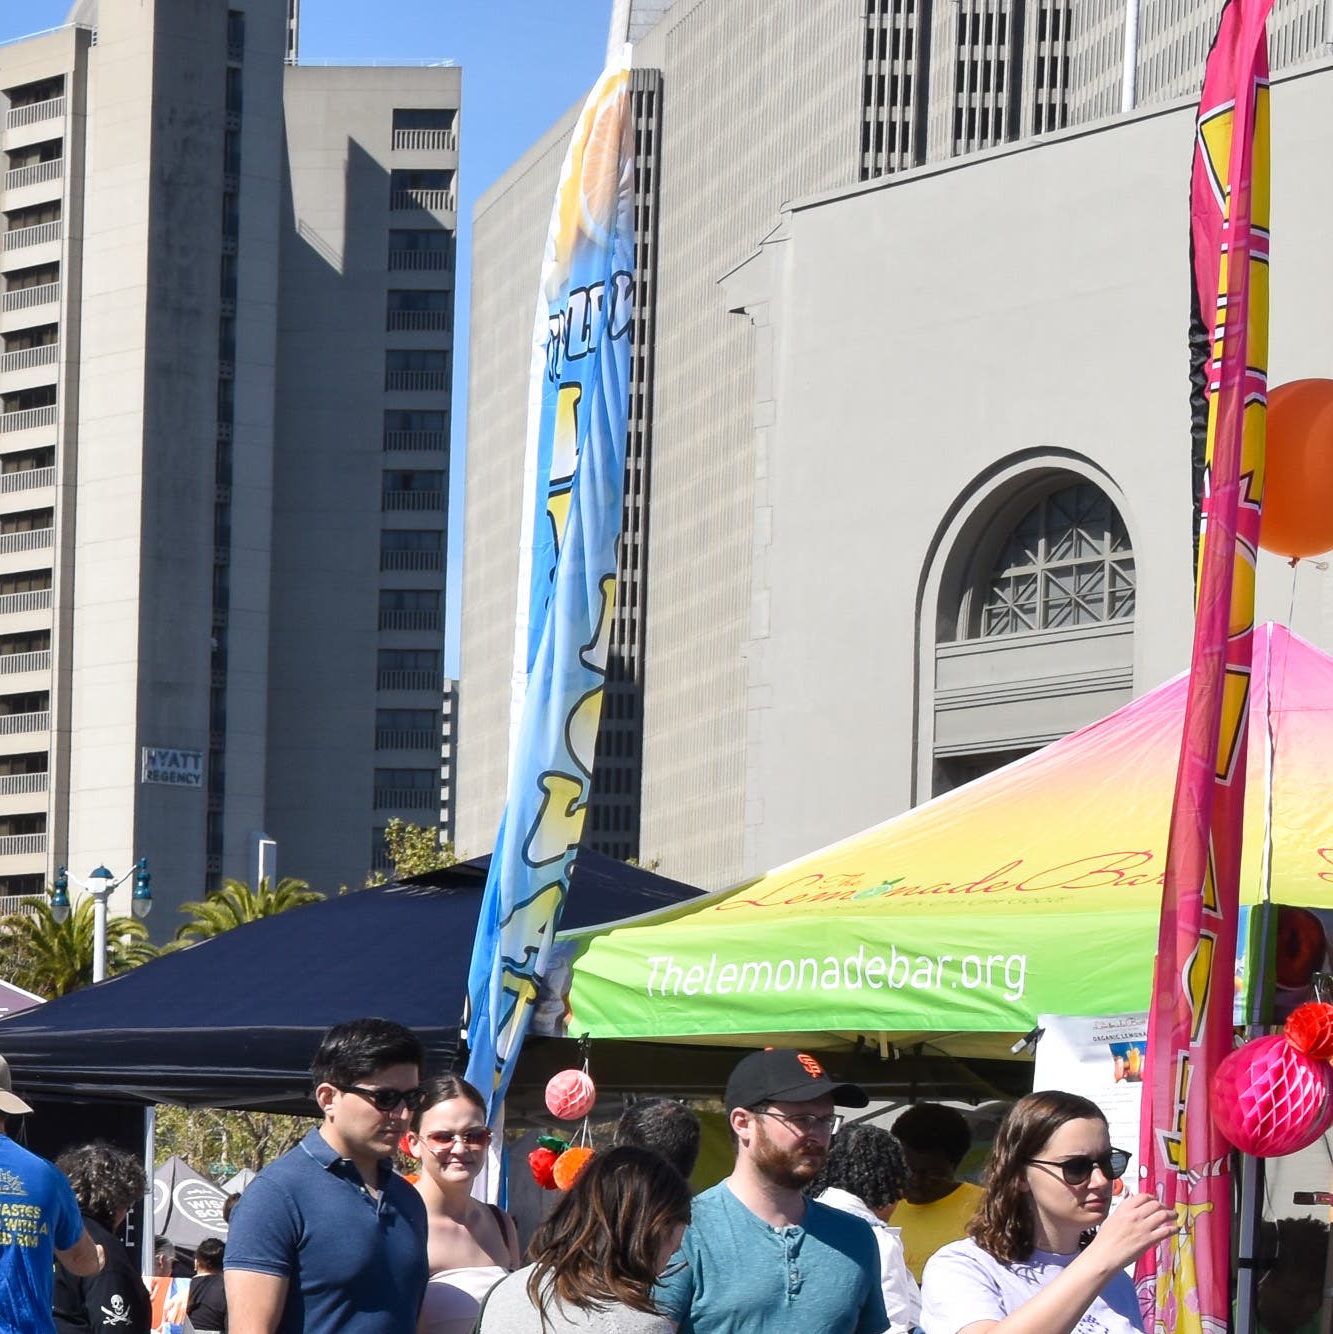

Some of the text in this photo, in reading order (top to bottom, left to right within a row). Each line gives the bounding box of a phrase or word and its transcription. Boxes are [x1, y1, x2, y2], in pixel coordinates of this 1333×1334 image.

[145, 750, 202, 769] HYATT
[145, 769, 201, 784] REGENCY
[646, 944, 1026, 1001] Thelemonadebar.org
